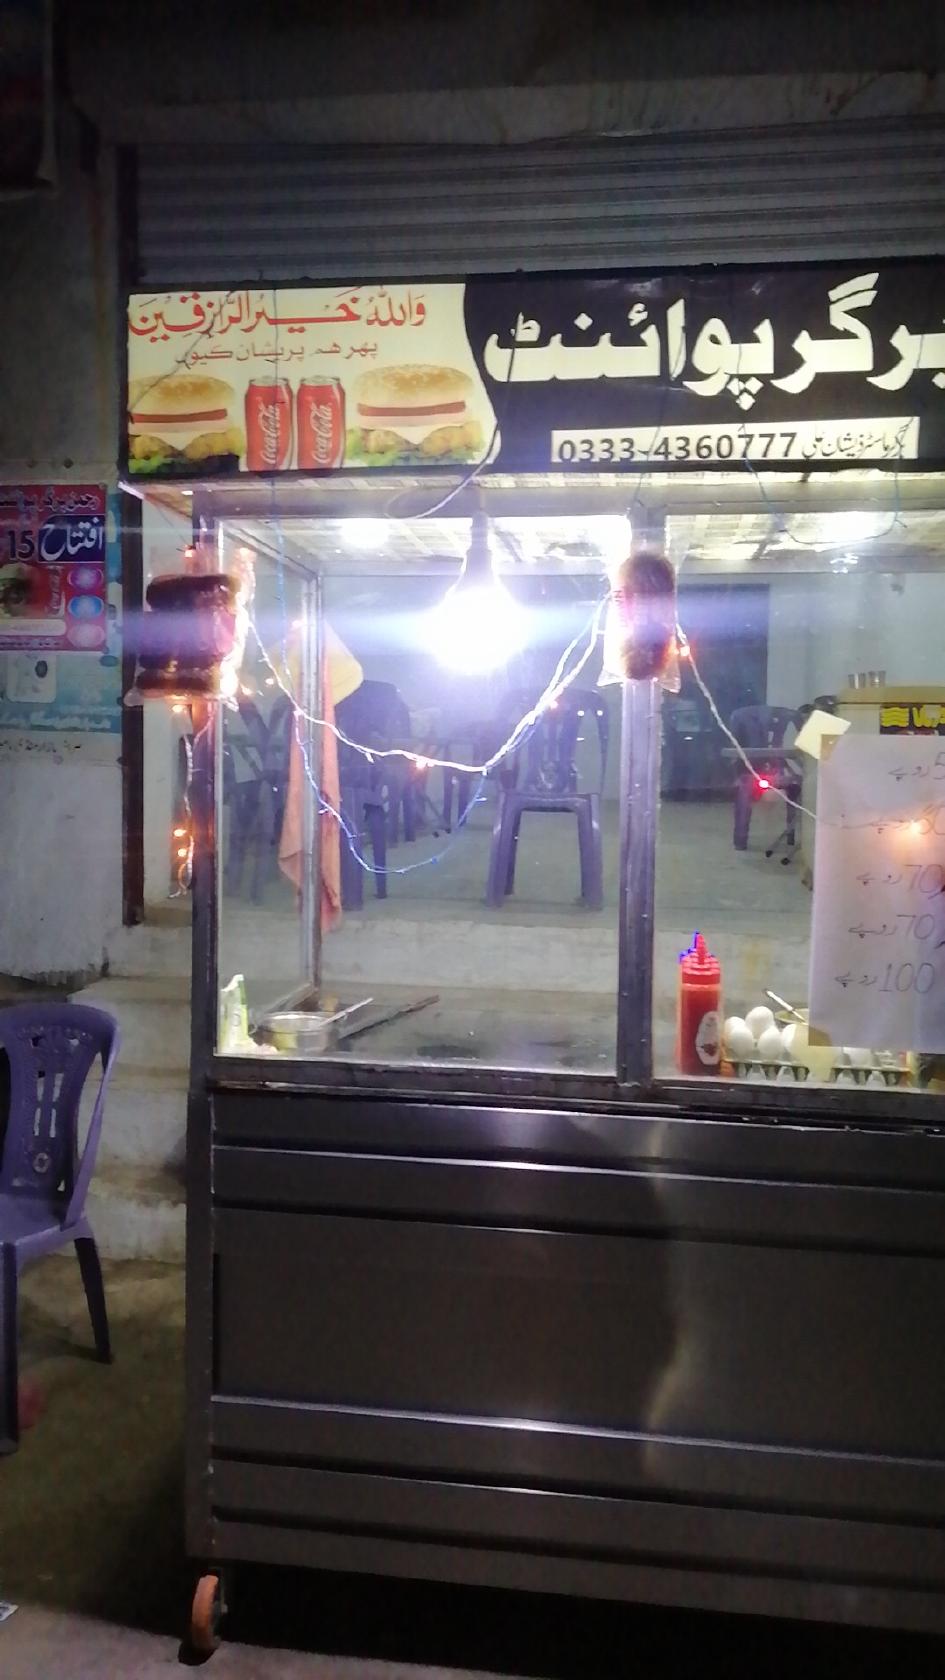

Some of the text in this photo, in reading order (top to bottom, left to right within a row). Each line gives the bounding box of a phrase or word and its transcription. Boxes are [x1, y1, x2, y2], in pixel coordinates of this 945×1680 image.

[484, 298, 775, 411] پوائنٹ
[40, 516, 104, 561] افتتاح
[879, 962, 936, 994] 100
